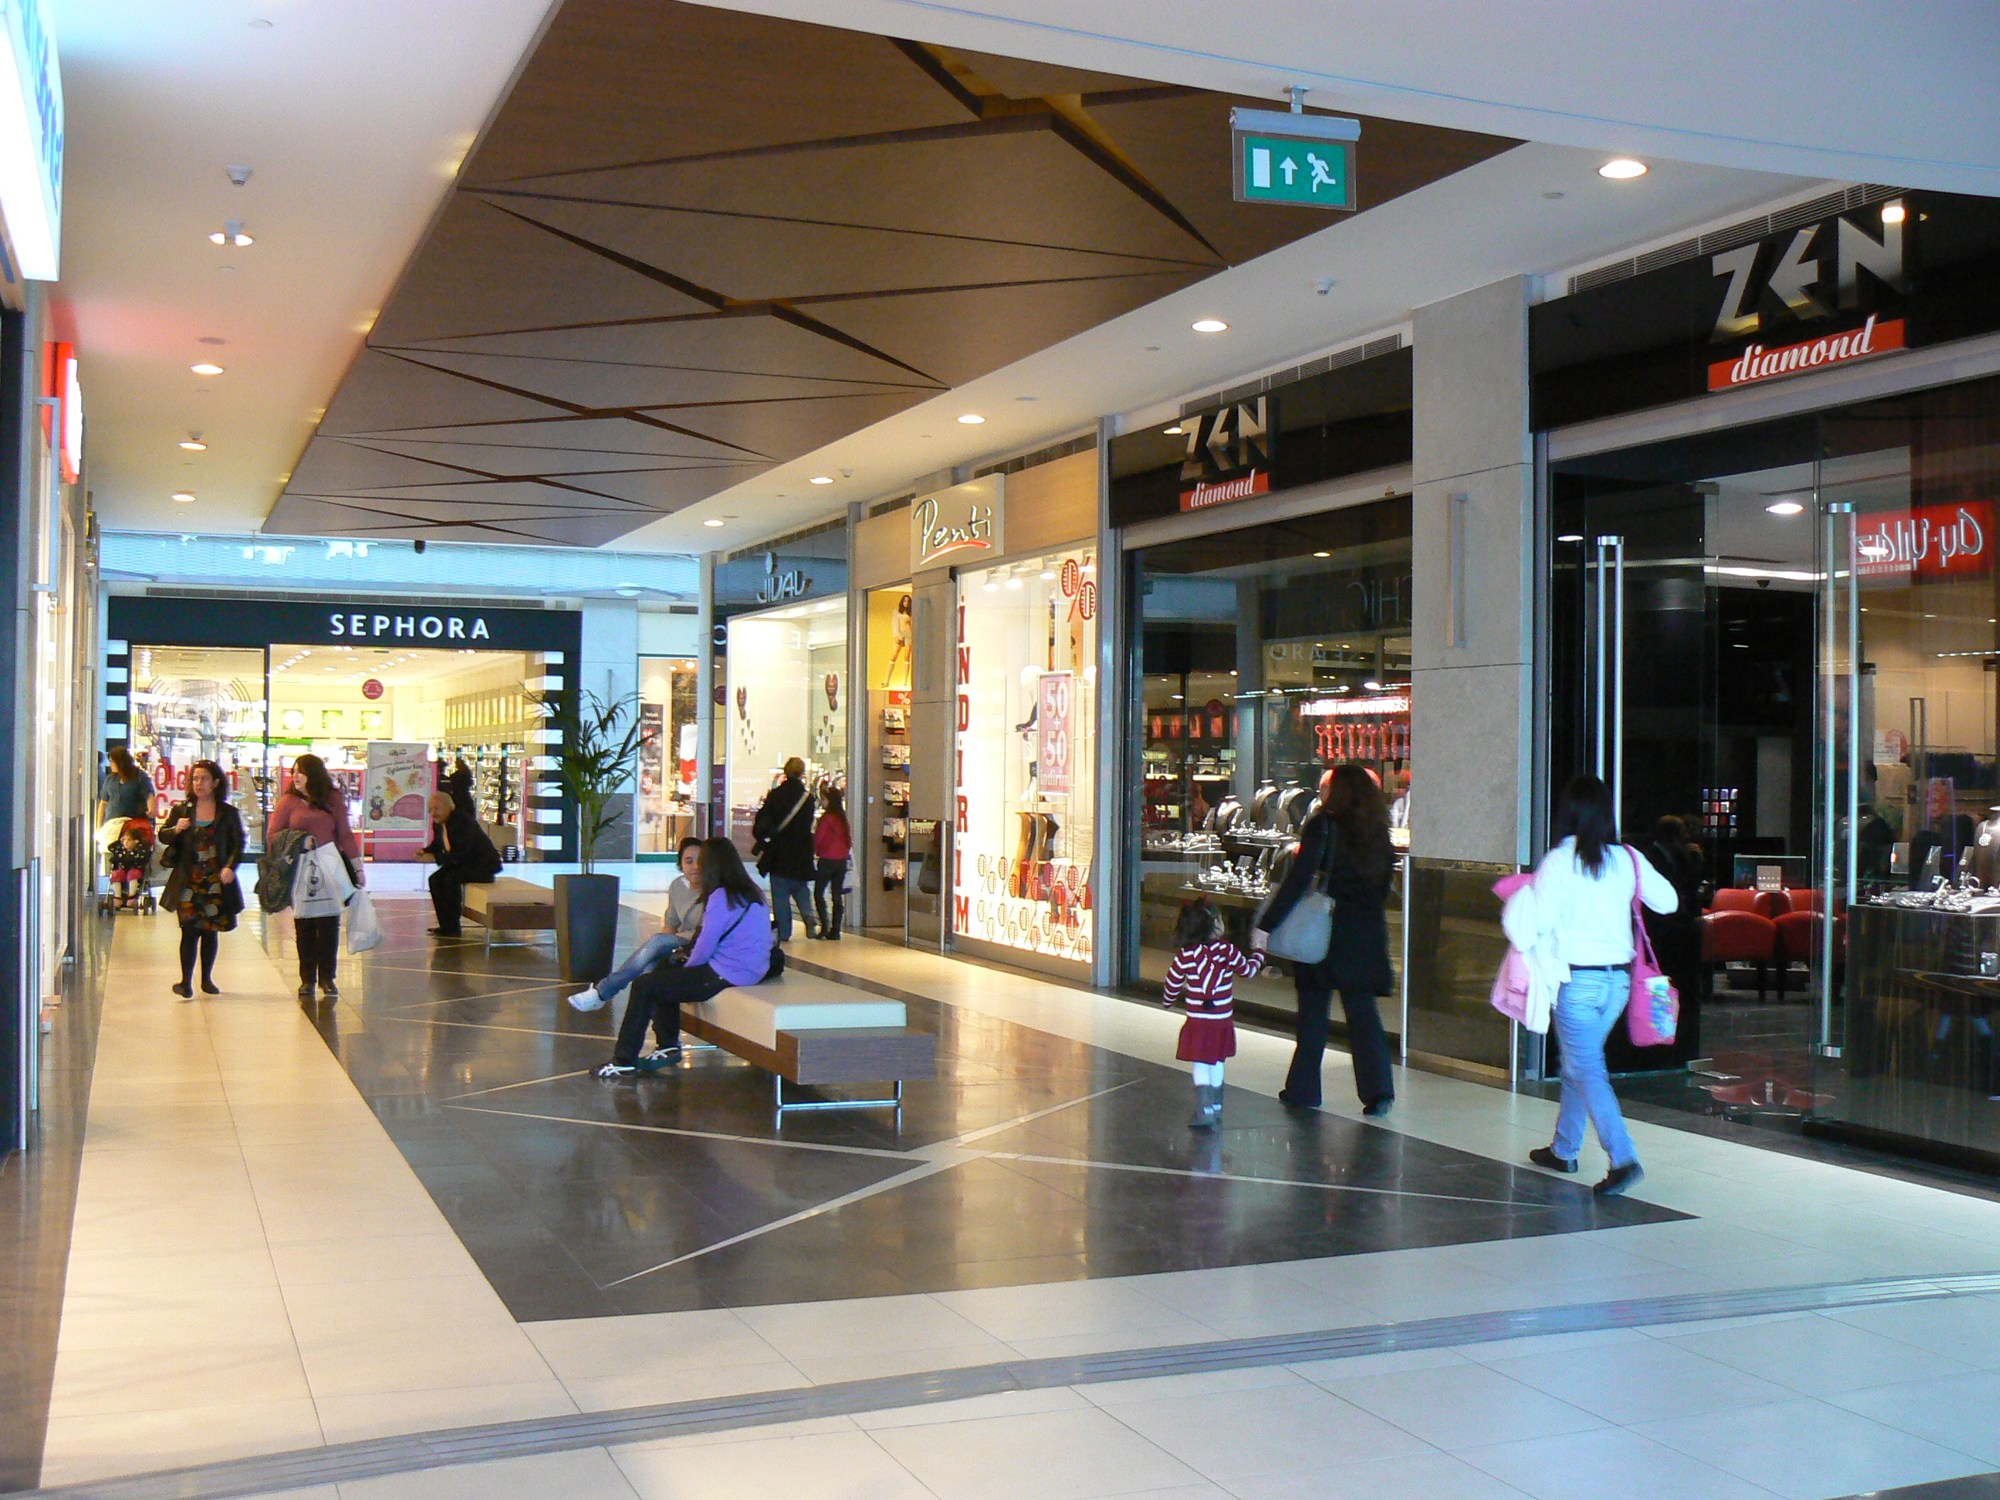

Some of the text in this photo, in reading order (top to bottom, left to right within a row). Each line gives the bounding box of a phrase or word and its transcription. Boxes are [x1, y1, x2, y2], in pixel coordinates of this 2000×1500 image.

[1709, 198, 1903, 345] ZEN
[1730, 313, 1877, 383] diamond
[1180, 395, 1267, 481] ZEN
[1190, 466, 1256, 508] diamond
[913, 498, 992, 556] Penti
[329, 613, 490, 640] SEPHORA
[1046, 681, 1068, 718] 50
[1046, 730, 1068, 767] 50
